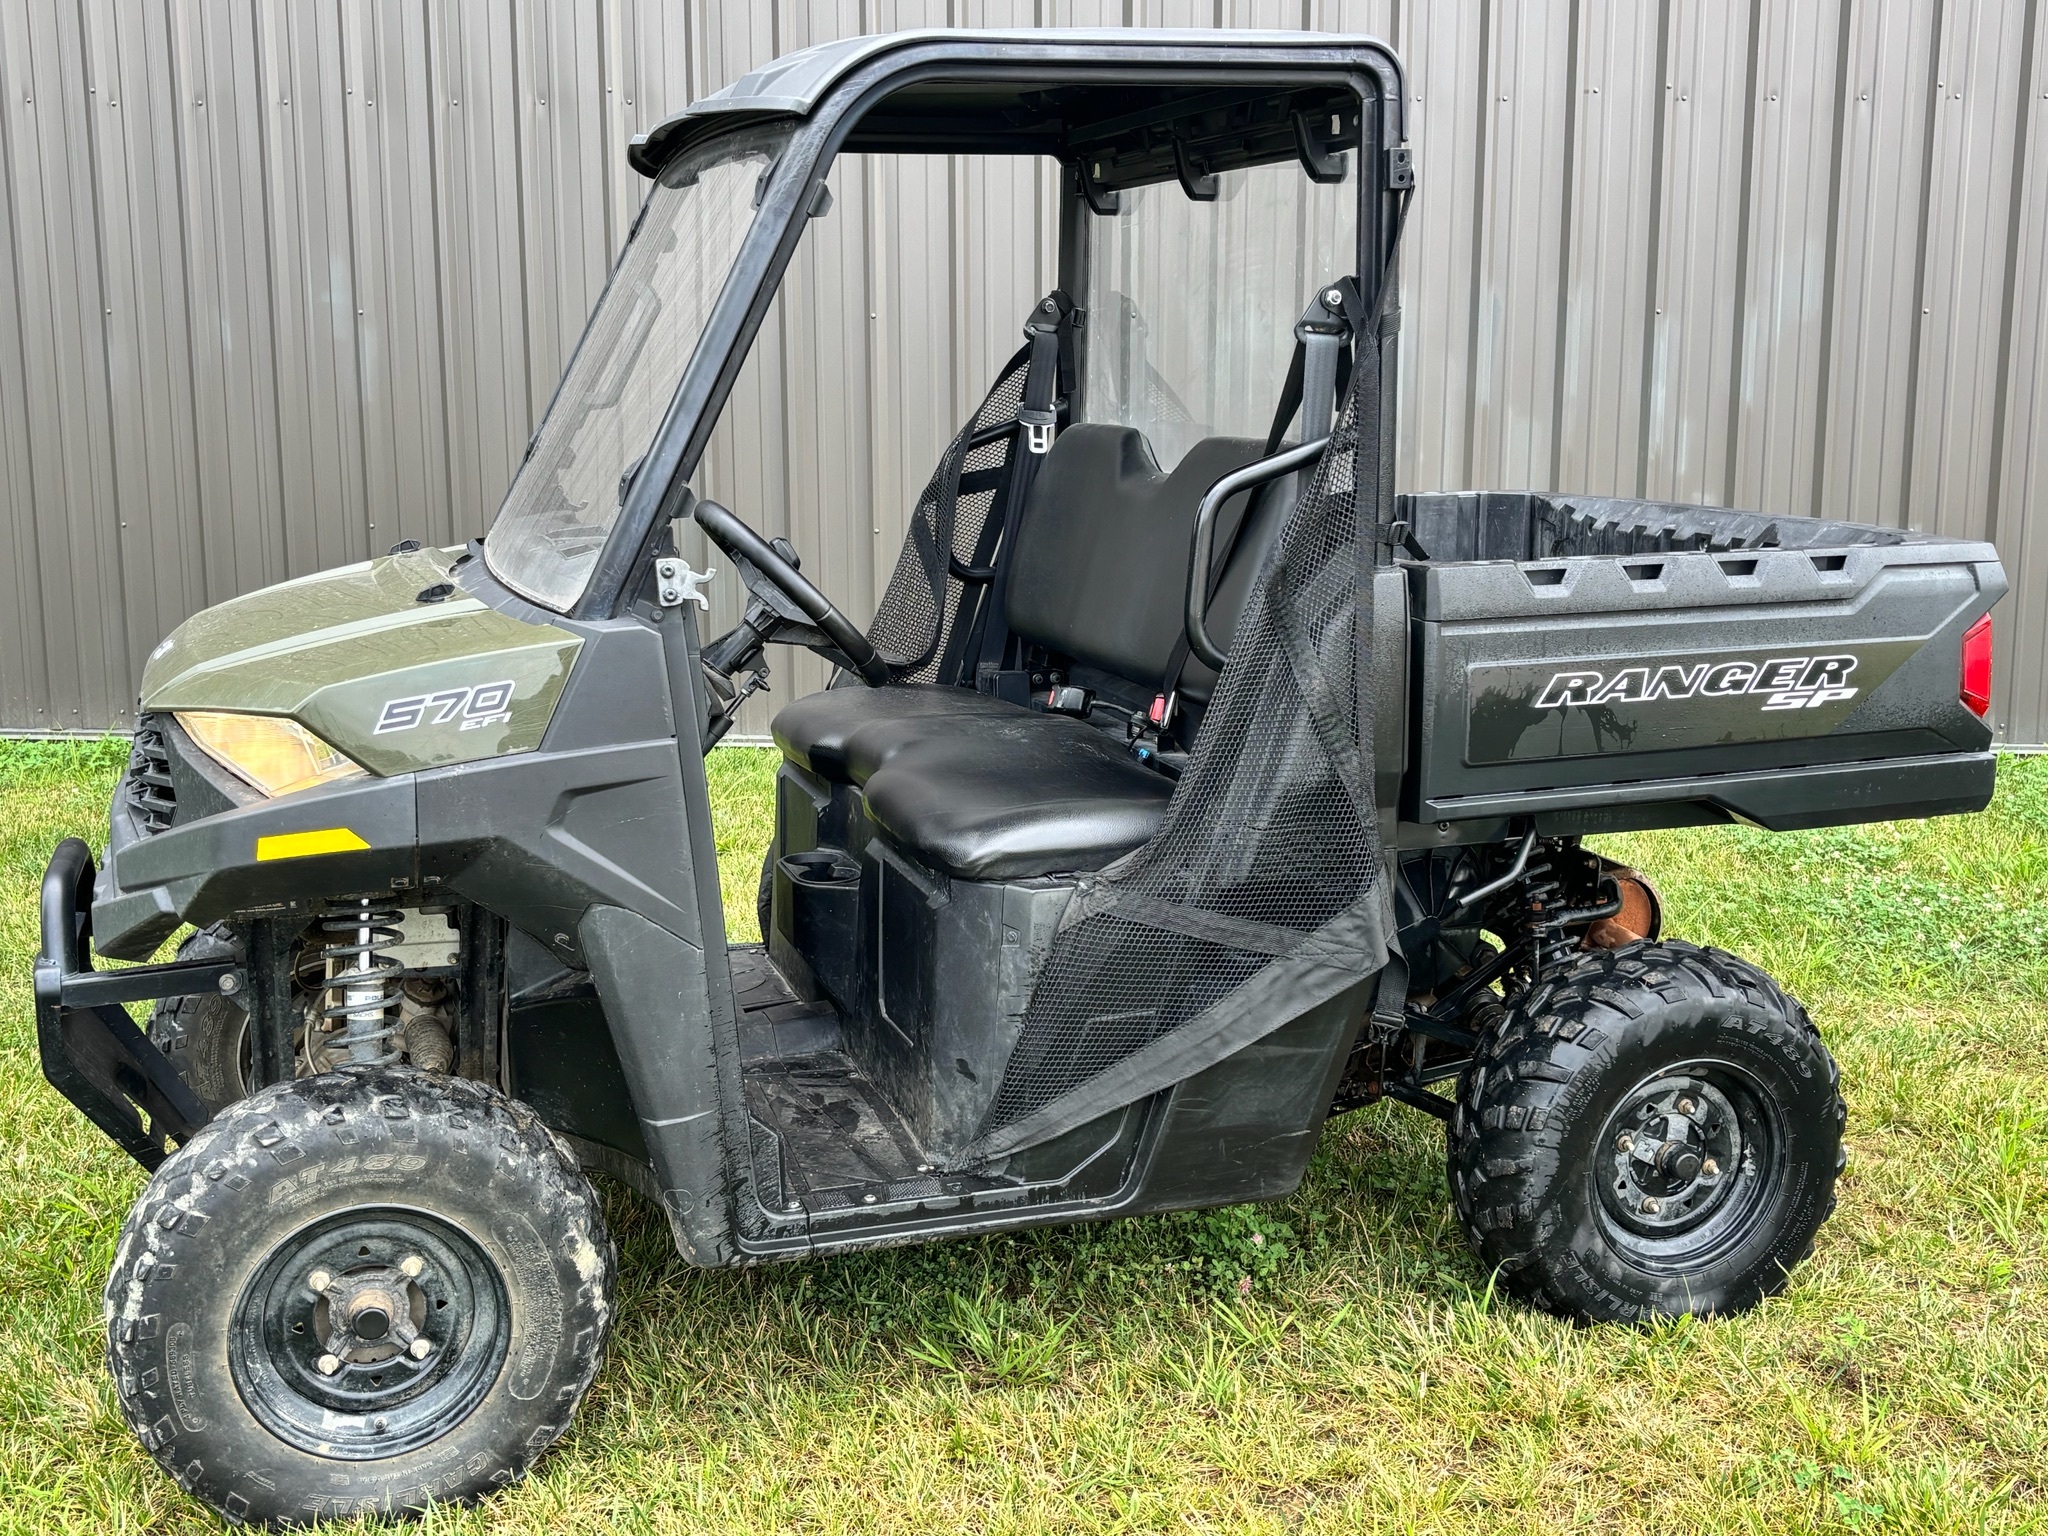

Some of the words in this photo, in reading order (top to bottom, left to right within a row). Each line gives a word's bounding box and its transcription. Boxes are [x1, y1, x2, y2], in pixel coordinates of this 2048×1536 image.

[373, 679, 516, 735] 570
[1535, 654, 1858, 708] RANGER
[1760, 687, 1859, 711] SP
[459, 711, 513, 732] EFI
[1720, 1014, 1813, 1079] AT489
[269, 1153, 429, 1205] AT489
